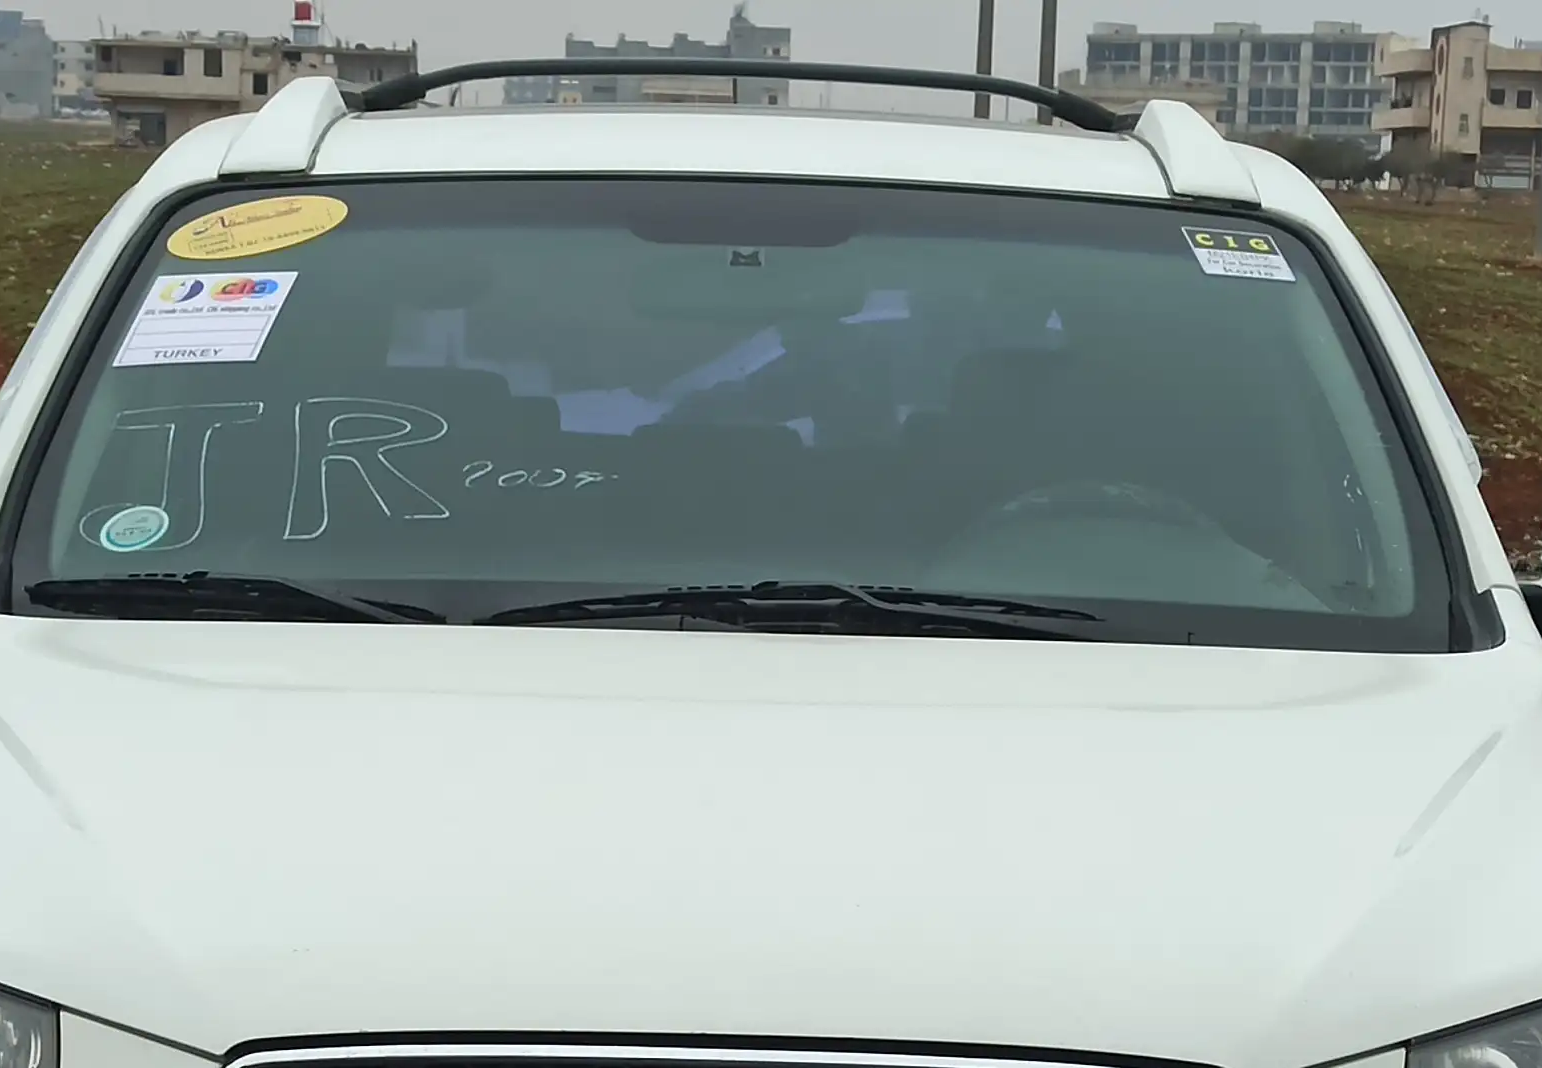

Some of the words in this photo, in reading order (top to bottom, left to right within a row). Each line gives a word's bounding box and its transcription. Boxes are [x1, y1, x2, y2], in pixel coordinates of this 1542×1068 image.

[1195, 233, 1271, 251] CIG
[220, 282, 268, 296] CIG
[153, 348, 223, 360] TURKEY
